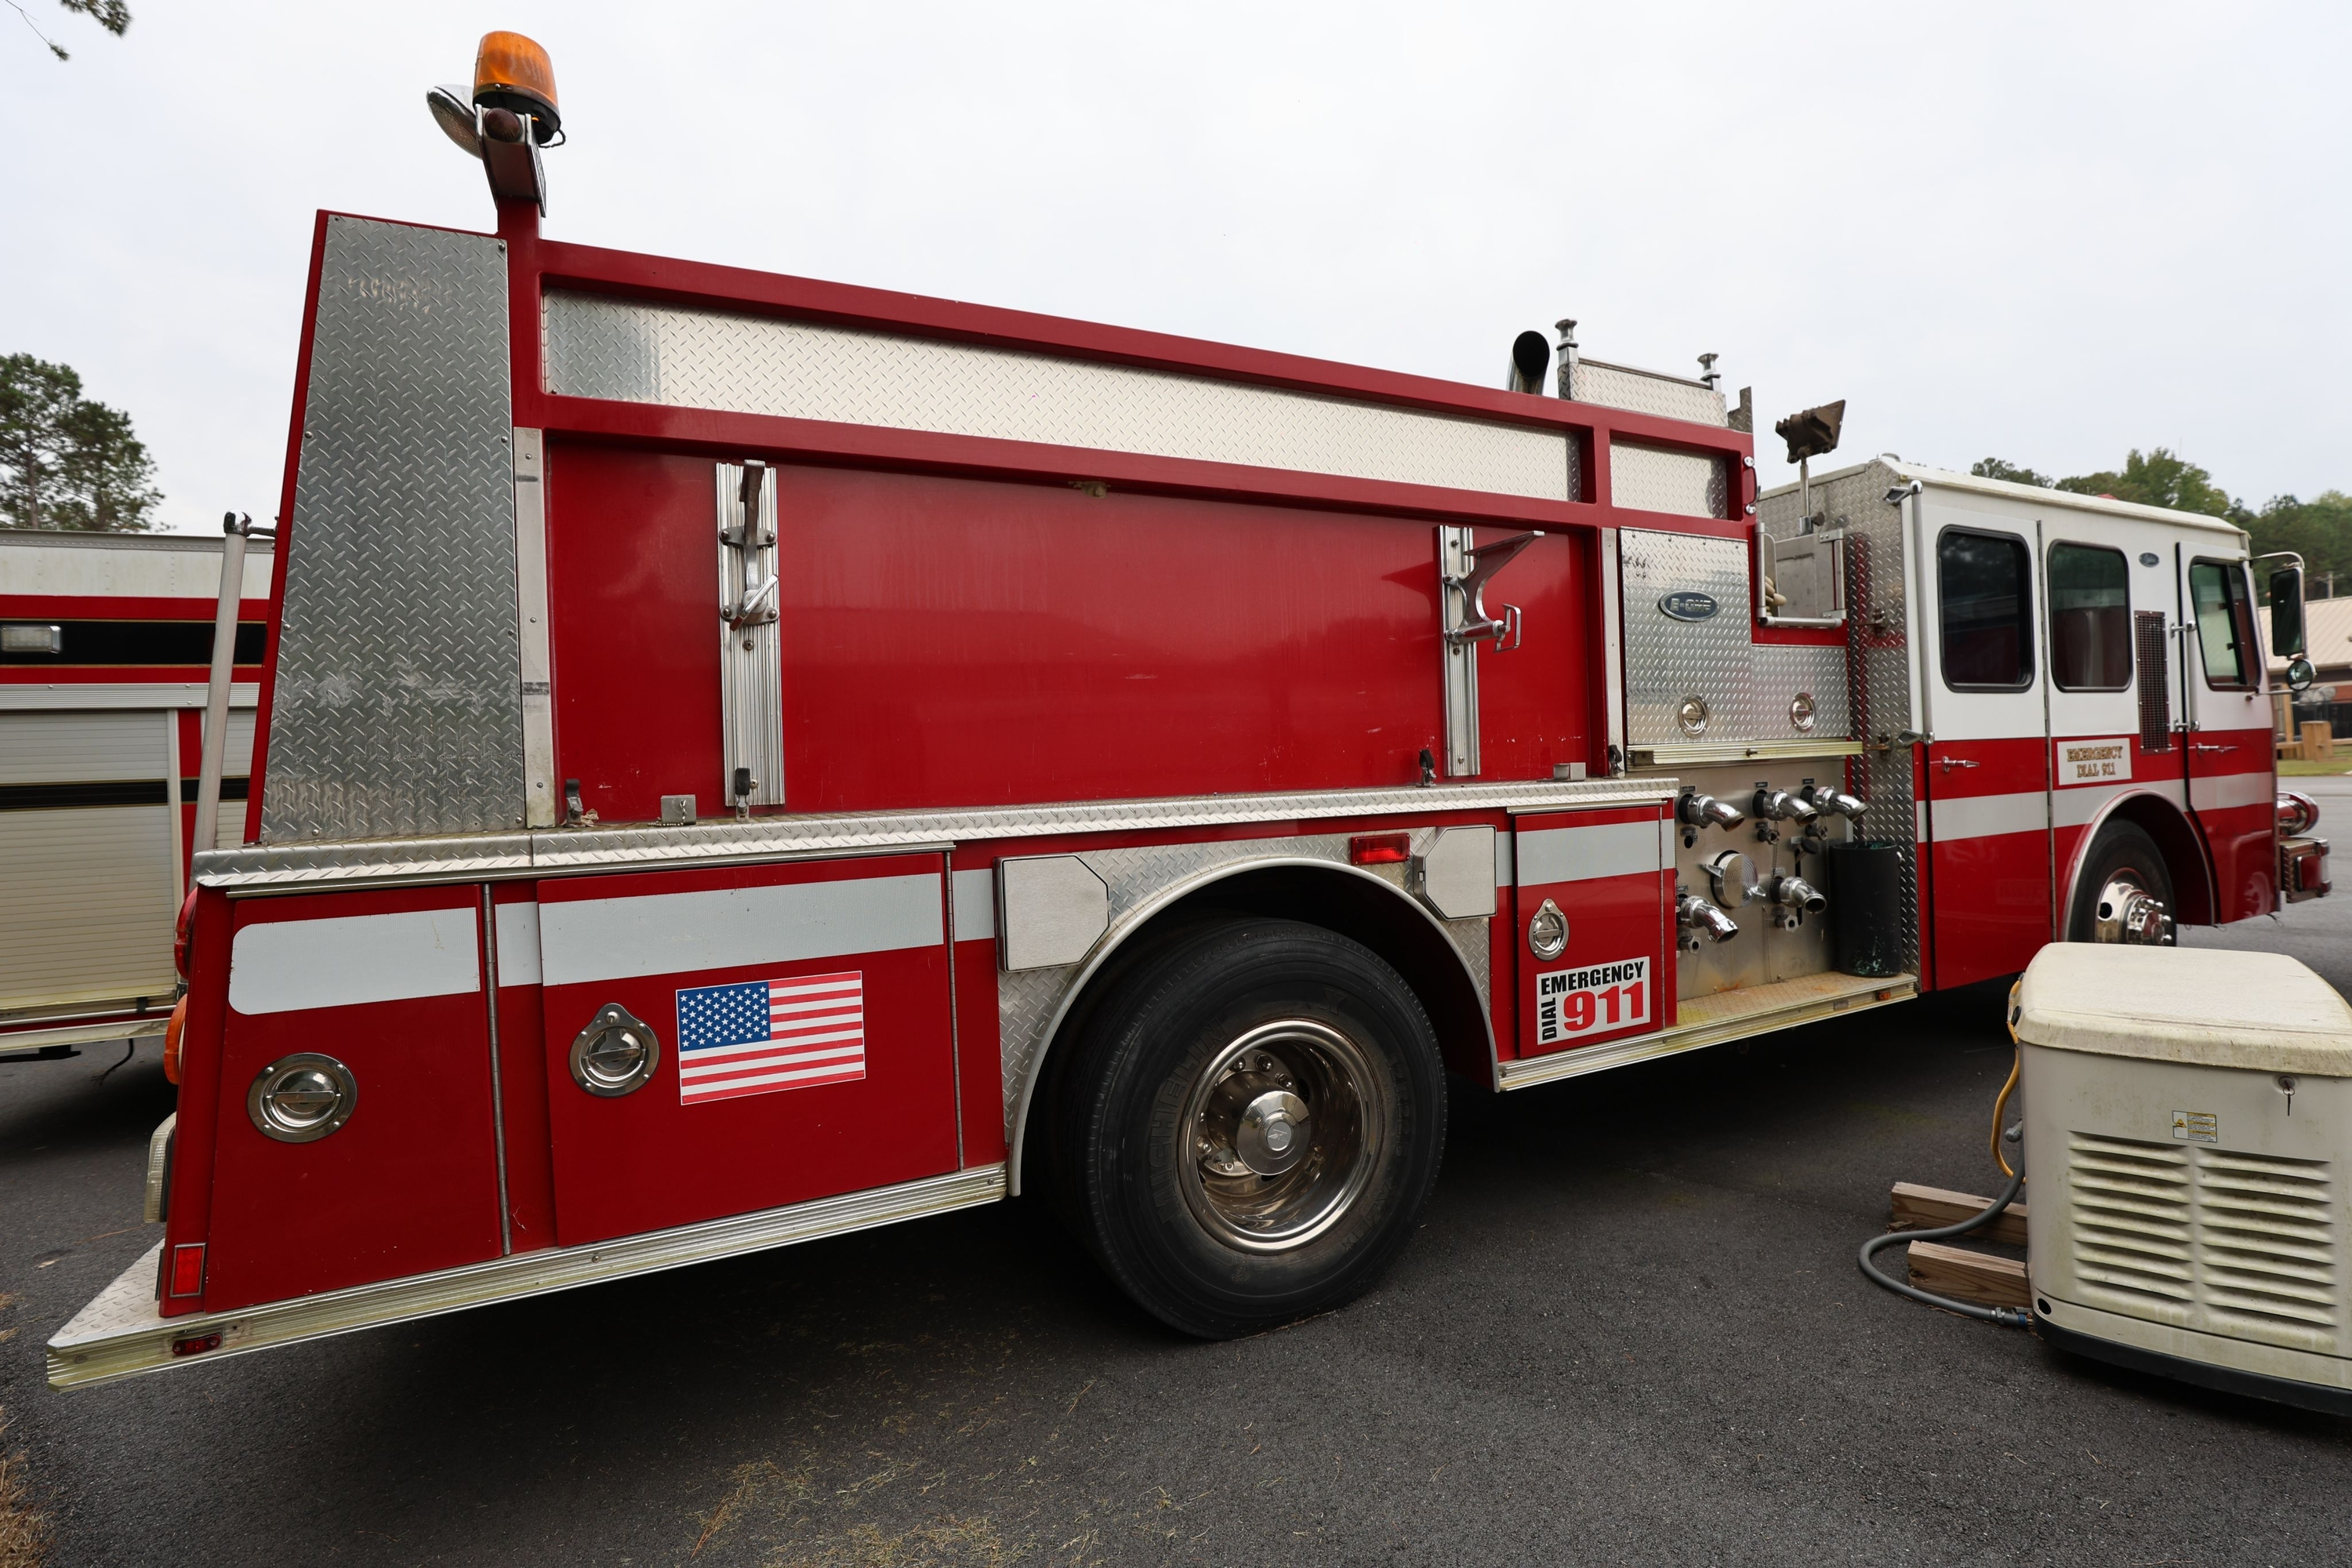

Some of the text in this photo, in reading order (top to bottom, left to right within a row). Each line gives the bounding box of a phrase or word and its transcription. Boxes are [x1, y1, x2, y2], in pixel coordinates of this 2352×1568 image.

[1670, 598, 1711, 612] E-ONE
[2067, 746, 2122, 761] EMERGENCY
[2077, 762, 2115, 777] DIAL 911
[1541, 961, 1644, 996] EMERGENCY
[1541, 997, 1557, 1041] DIAL
[1563, 981, 1644, 1031] 911
[1149, 1017, 1227, 1225] MICHELIN
